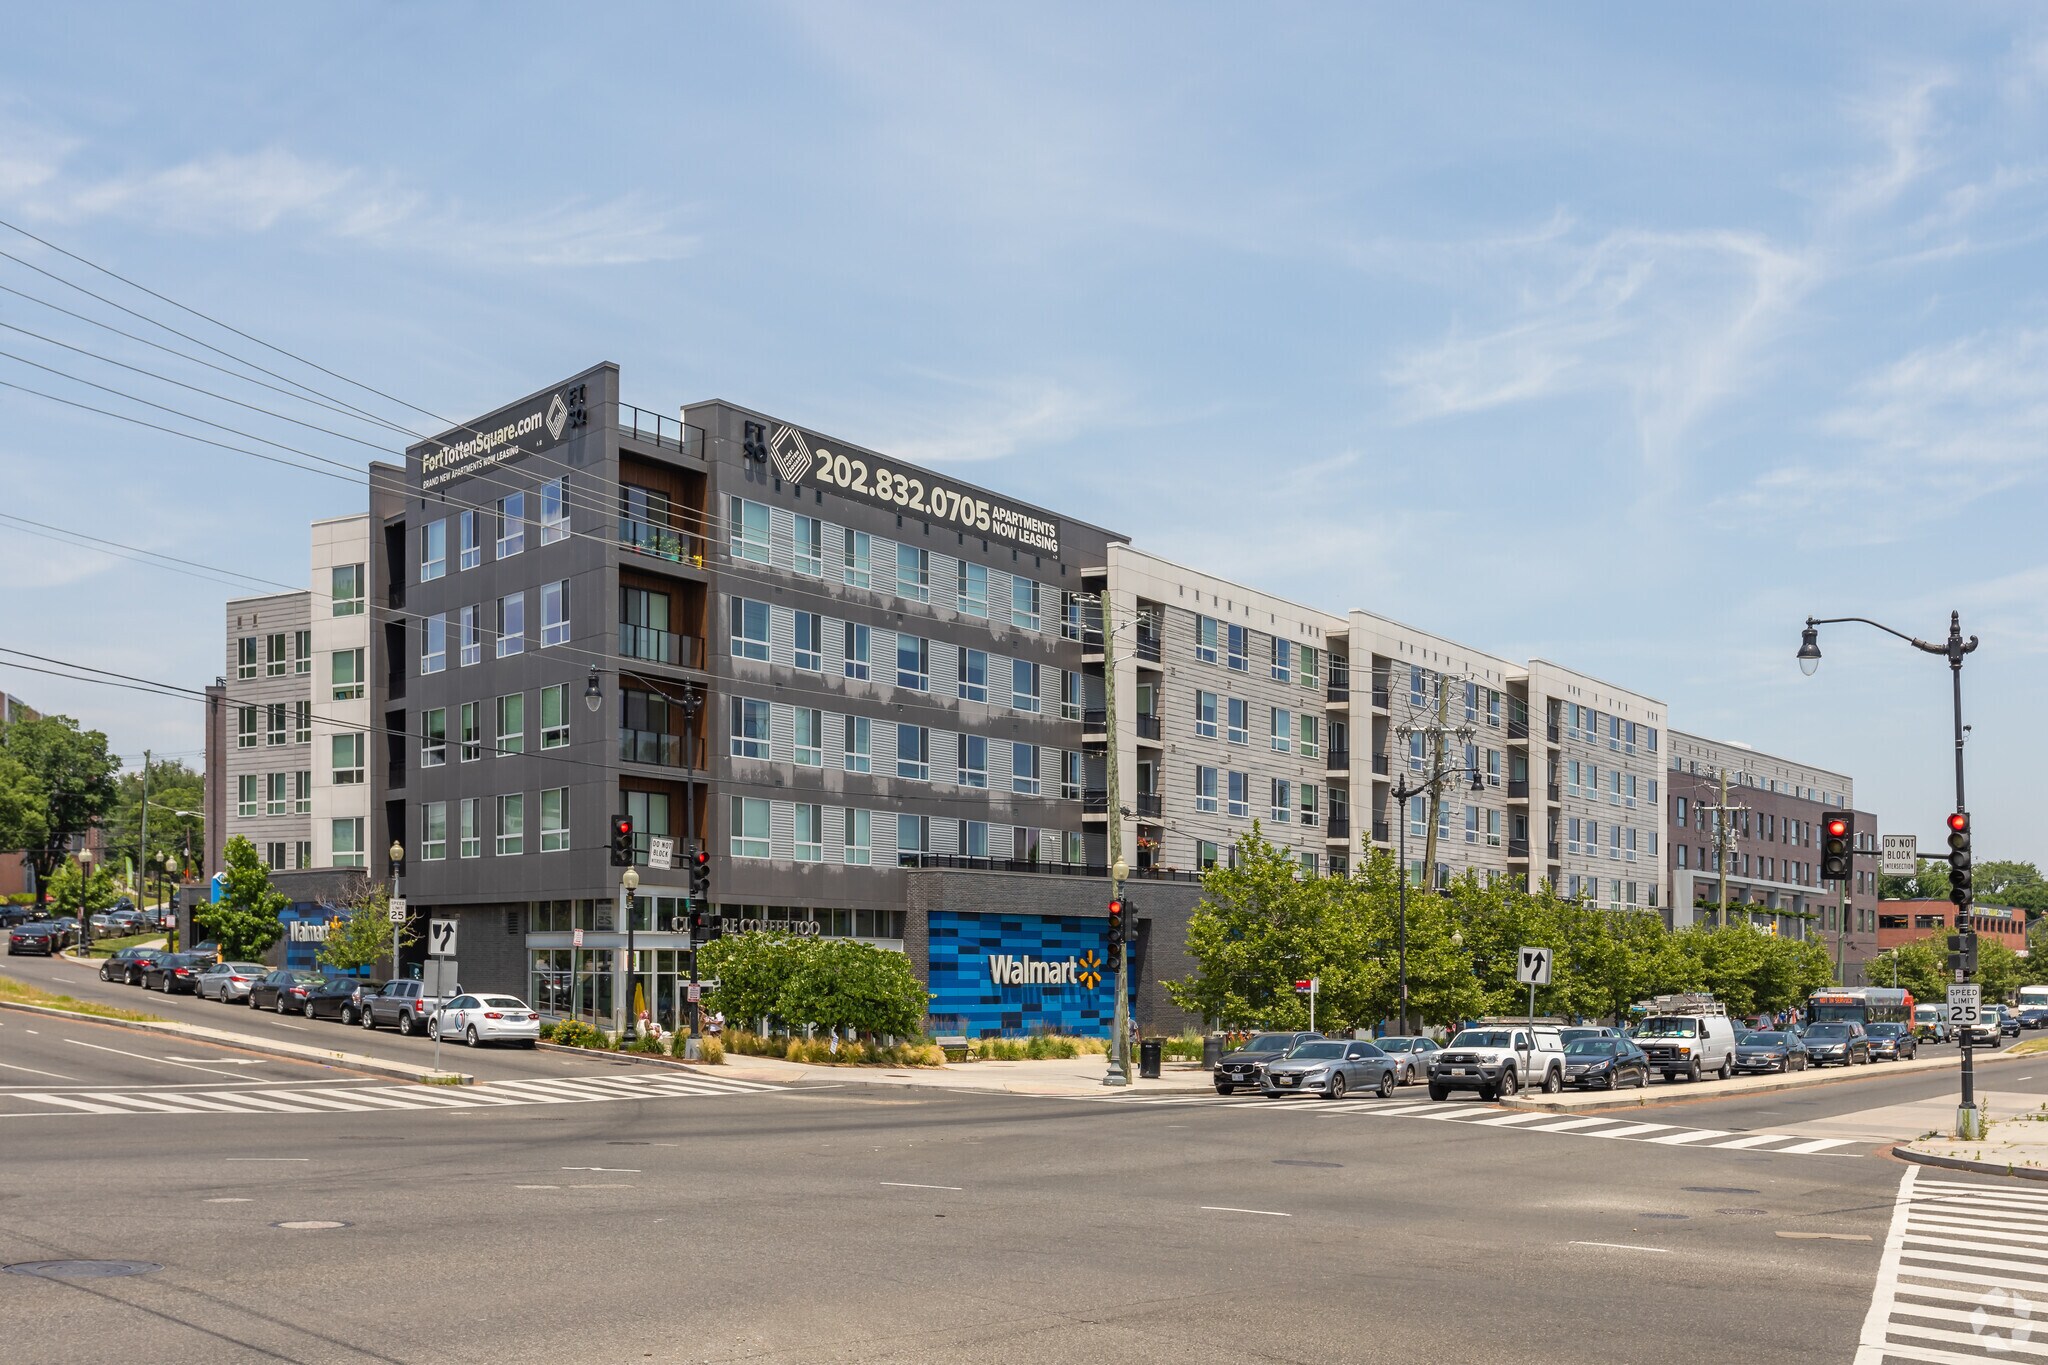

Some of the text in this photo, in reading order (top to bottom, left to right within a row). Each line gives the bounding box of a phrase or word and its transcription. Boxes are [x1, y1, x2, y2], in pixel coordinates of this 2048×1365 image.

[745, 420, 766, 442] FT
[423, 411, 542, 473] FortTottenSquare.com
[422, 445, 519, 490] BRAND NEW APARTMENTS NOW LEASING
[816, 448, 990, 531] 202.832.0705
[992, 505, 1056, 537] APARTMENTS
[993, 520, 1058, 552] NOW LEASING
[652, 840, 672, 849] DO NOT
[653, 849, 669, 858] BLOCK
[1885, 839, 1914, 848] DO NOT
[1887, 850, 1911, 860] BLOCK
[391, 910, 404, 920] 25
[290, 921, 330, 942] Walmart
[791, 920, 820, 936] TOO
[989, 954, 1078, 985] Walmart
[1951, 1006, 1977, 1021] 25
